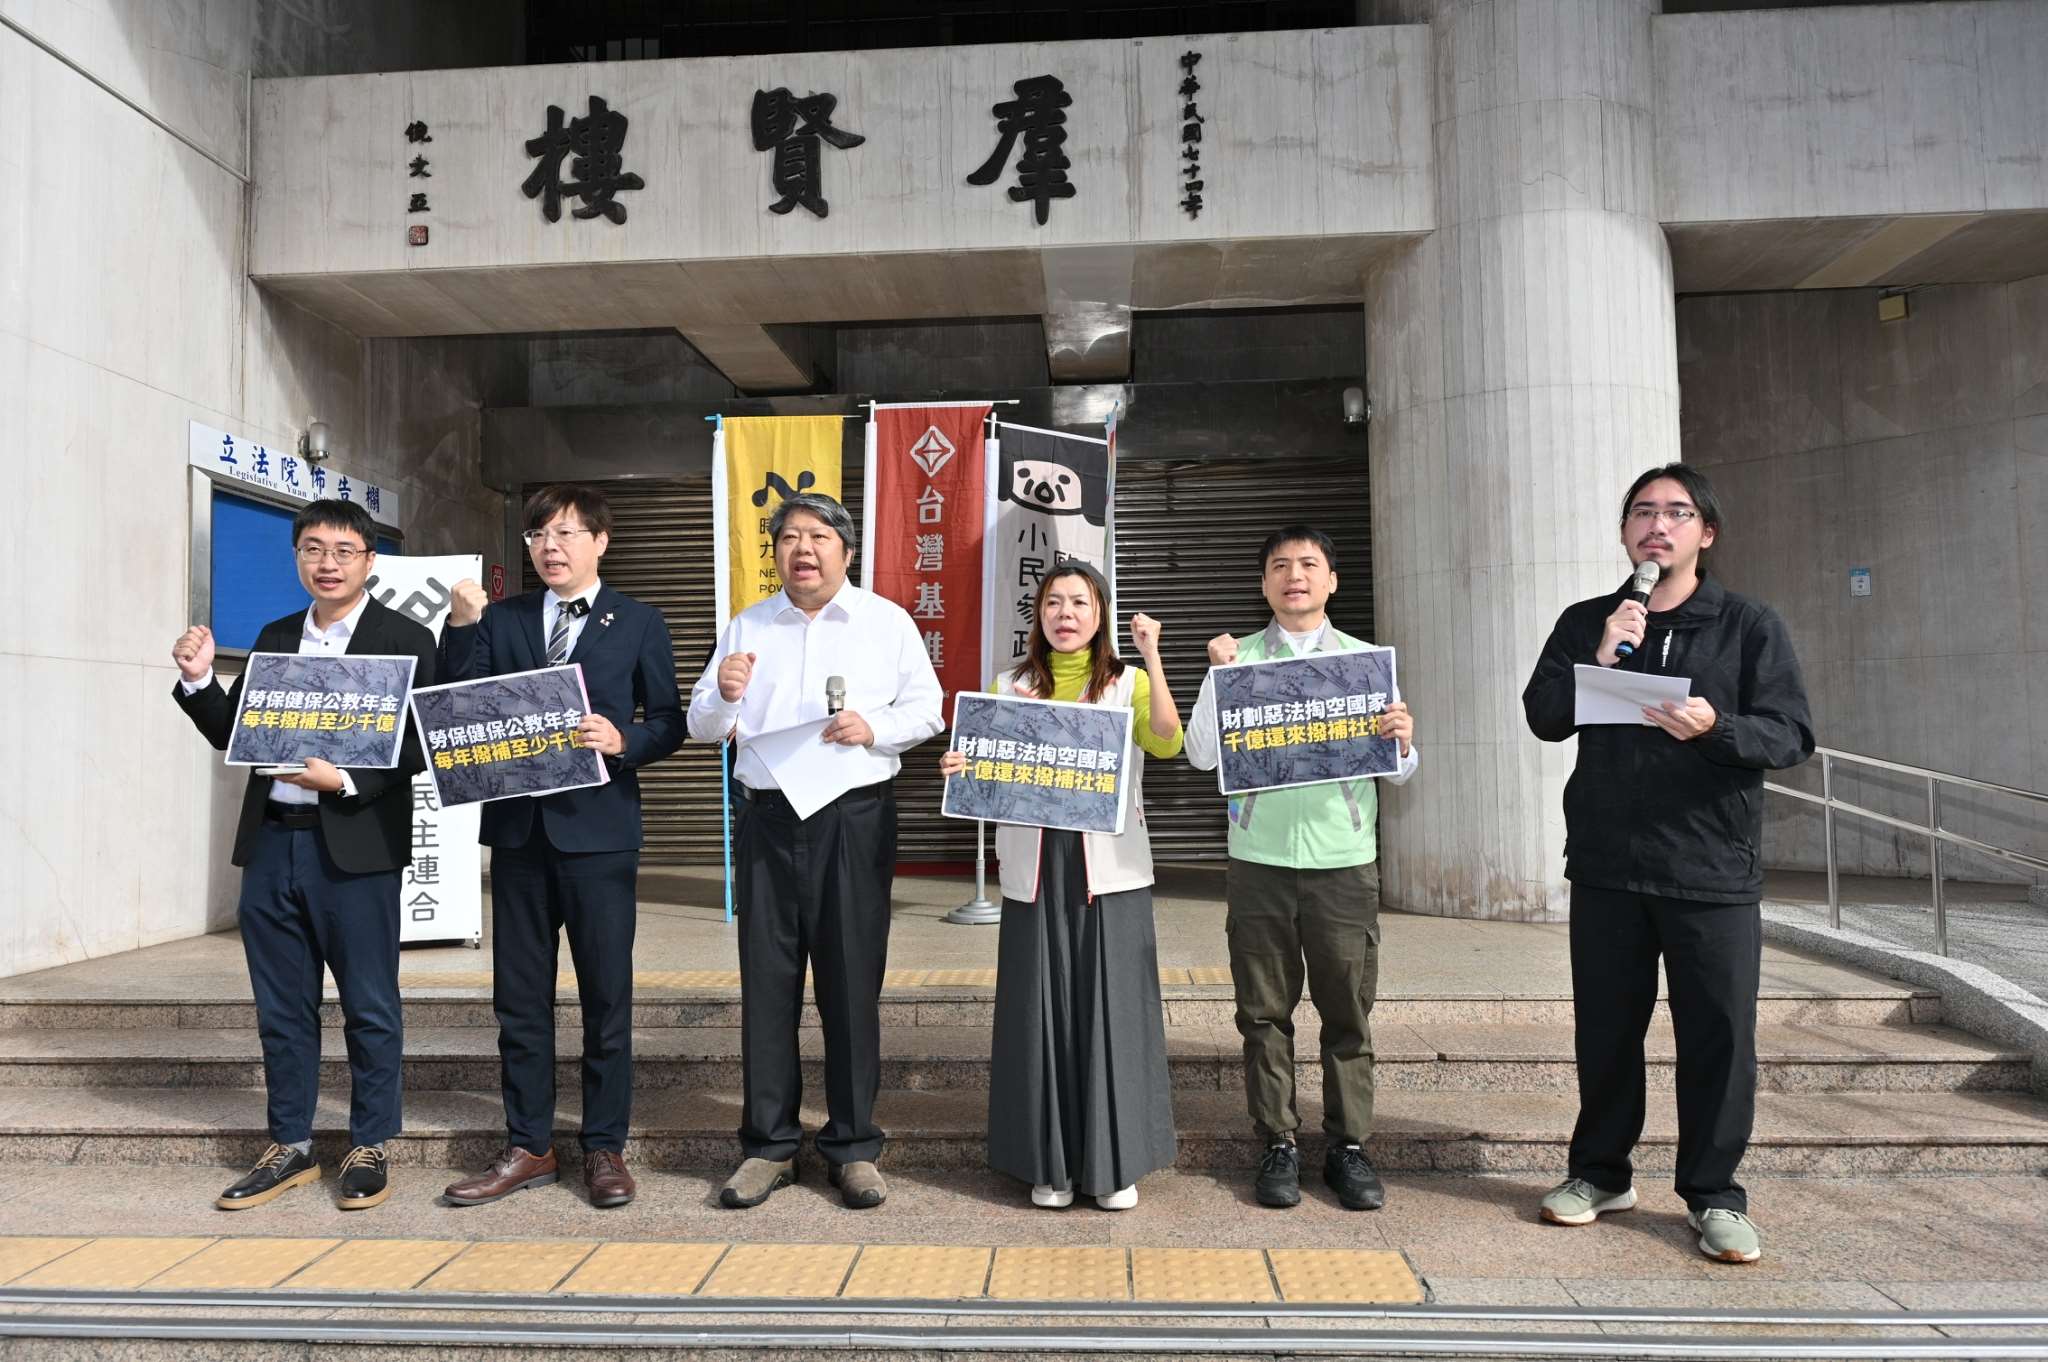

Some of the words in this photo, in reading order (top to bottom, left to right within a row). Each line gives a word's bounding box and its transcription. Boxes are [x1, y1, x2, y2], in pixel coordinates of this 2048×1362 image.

[219, 434, 380, 513] 立法院佈告欄
[229, 466, 278, 489] Legislative
[286, 484, 307, 498] Yuan
[246, 690, 399, 712] 勞保健保公教年金
[1222, 692, 1388, 731] 財劃惡法掏空國家
[241, 709, 397, 733] 每年撥補至少千億
[427, 707, 582, 750] 勞保健保公教年金
[957, 735, 1118, 771] 財劃惡法掏空國家
[407, 783, 440, 922] 民主連合
